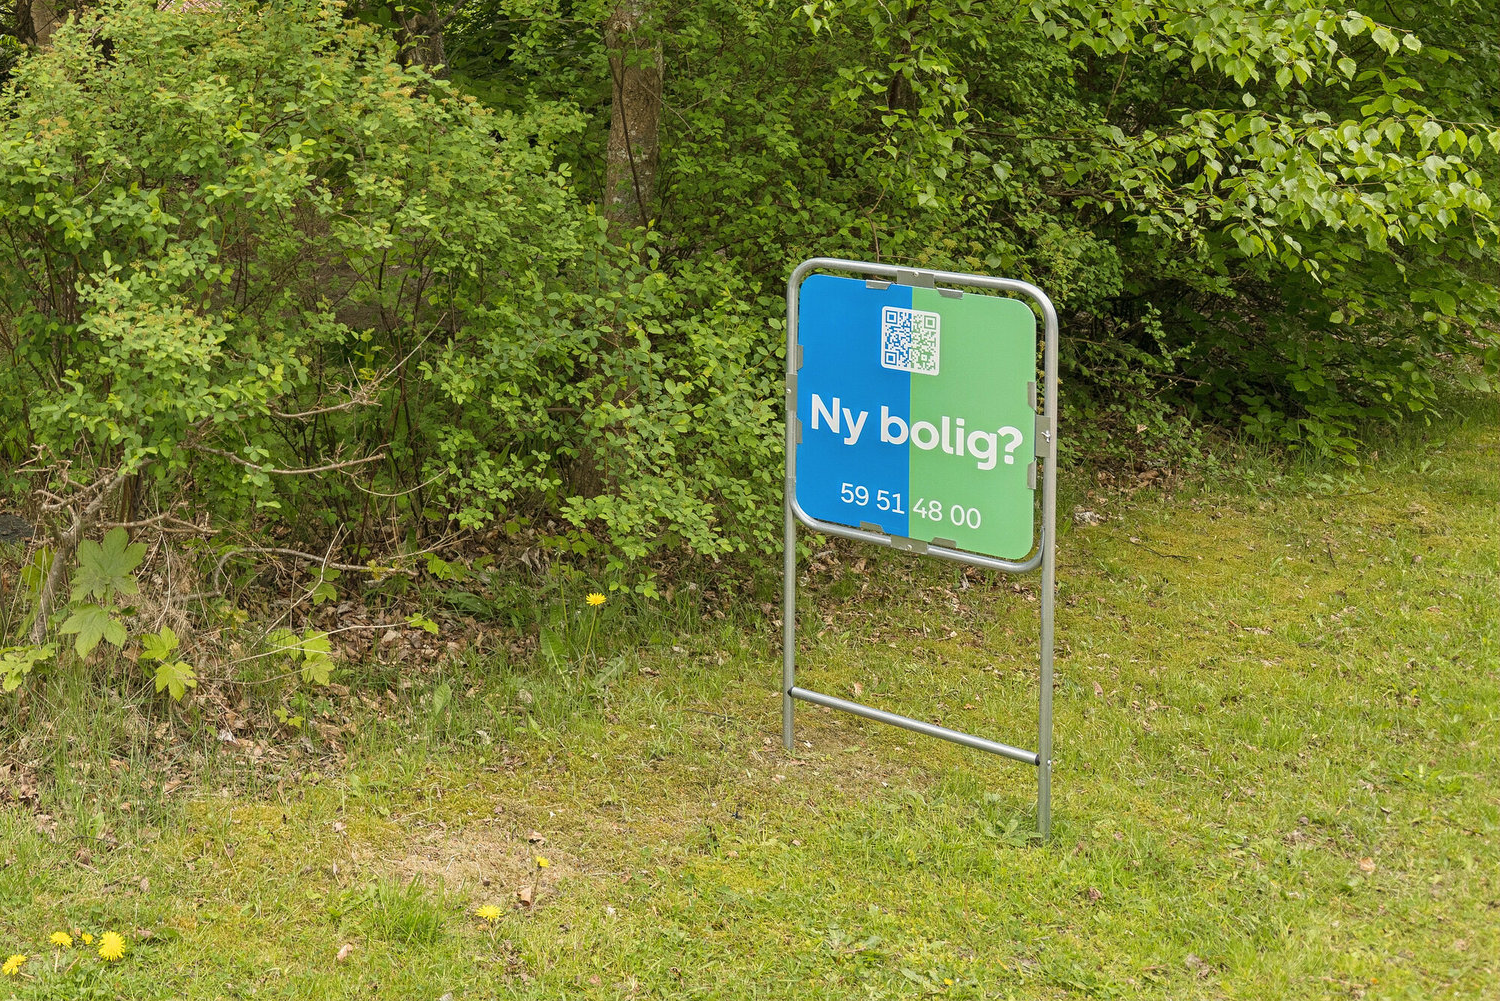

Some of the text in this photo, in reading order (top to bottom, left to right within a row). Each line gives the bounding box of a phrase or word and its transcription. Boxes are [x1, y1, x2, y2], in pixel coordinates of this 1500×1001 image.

[811, 393, 1023, 471] Ny bolig?
[840, 482, 982, 530] 59 51 48 00
